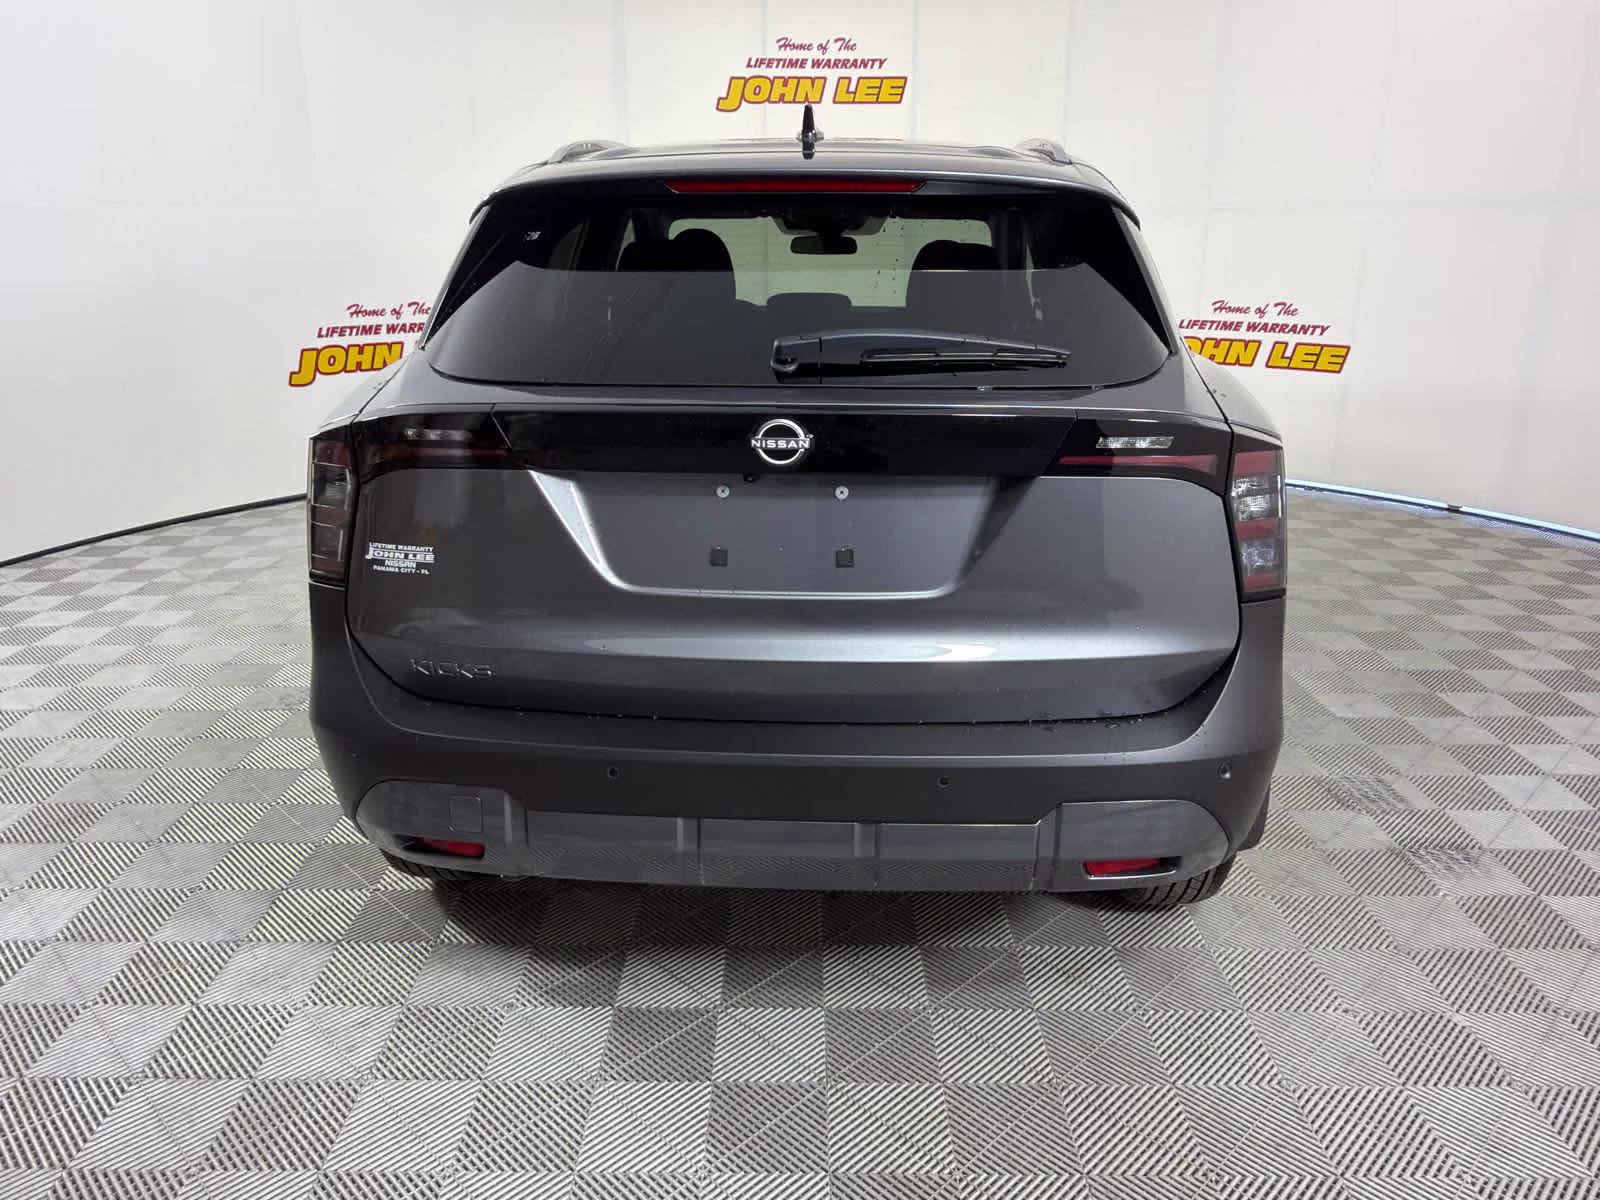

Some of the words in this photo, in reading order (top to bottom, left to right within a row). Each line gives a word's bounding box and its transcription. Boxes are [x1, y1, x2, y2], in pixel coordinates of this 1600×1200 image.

[776, 37, 813, 52] Home
[817, 39, 829, 55] of
[834, 38, 856, 51] The
[746, 57, 808, 69] LIFETIME
[811, 58, 887, 70] WARRANTY
[716, 75, 827, 112] JOHN
[832, 76, 907, 105] LEE
[346, 303, 386, 318] Home
[390, 304, 403, 320] of
[407, 301, 431, 316] The
[1211, 299, 1251, 315] Home
[1254, 303, 1269, 319] of
[1273, 302, 1299, 317] The
[316, 323, 382, 338] LIFETIME
[386, 322, 425, 335] WARR
[1178, 319, 1243, 332] LIFETIME
[1245, 321, 1331, 336] WARRANTY
[1183, 336, 1262, 367] OHN
[1265, 341, 1351, 374] LEE
[288, 341, 404, 387] JOHN
[751, 439, 810, 449] NISSAN
[365, 547, 405, 560] JOHN
[407, 553, 435, 561] LEE
[369, 542, 397, 550] LIFETIME
[385, 559, 417, 568] NISSAN
[409, 659, 493, 679] KICKS
